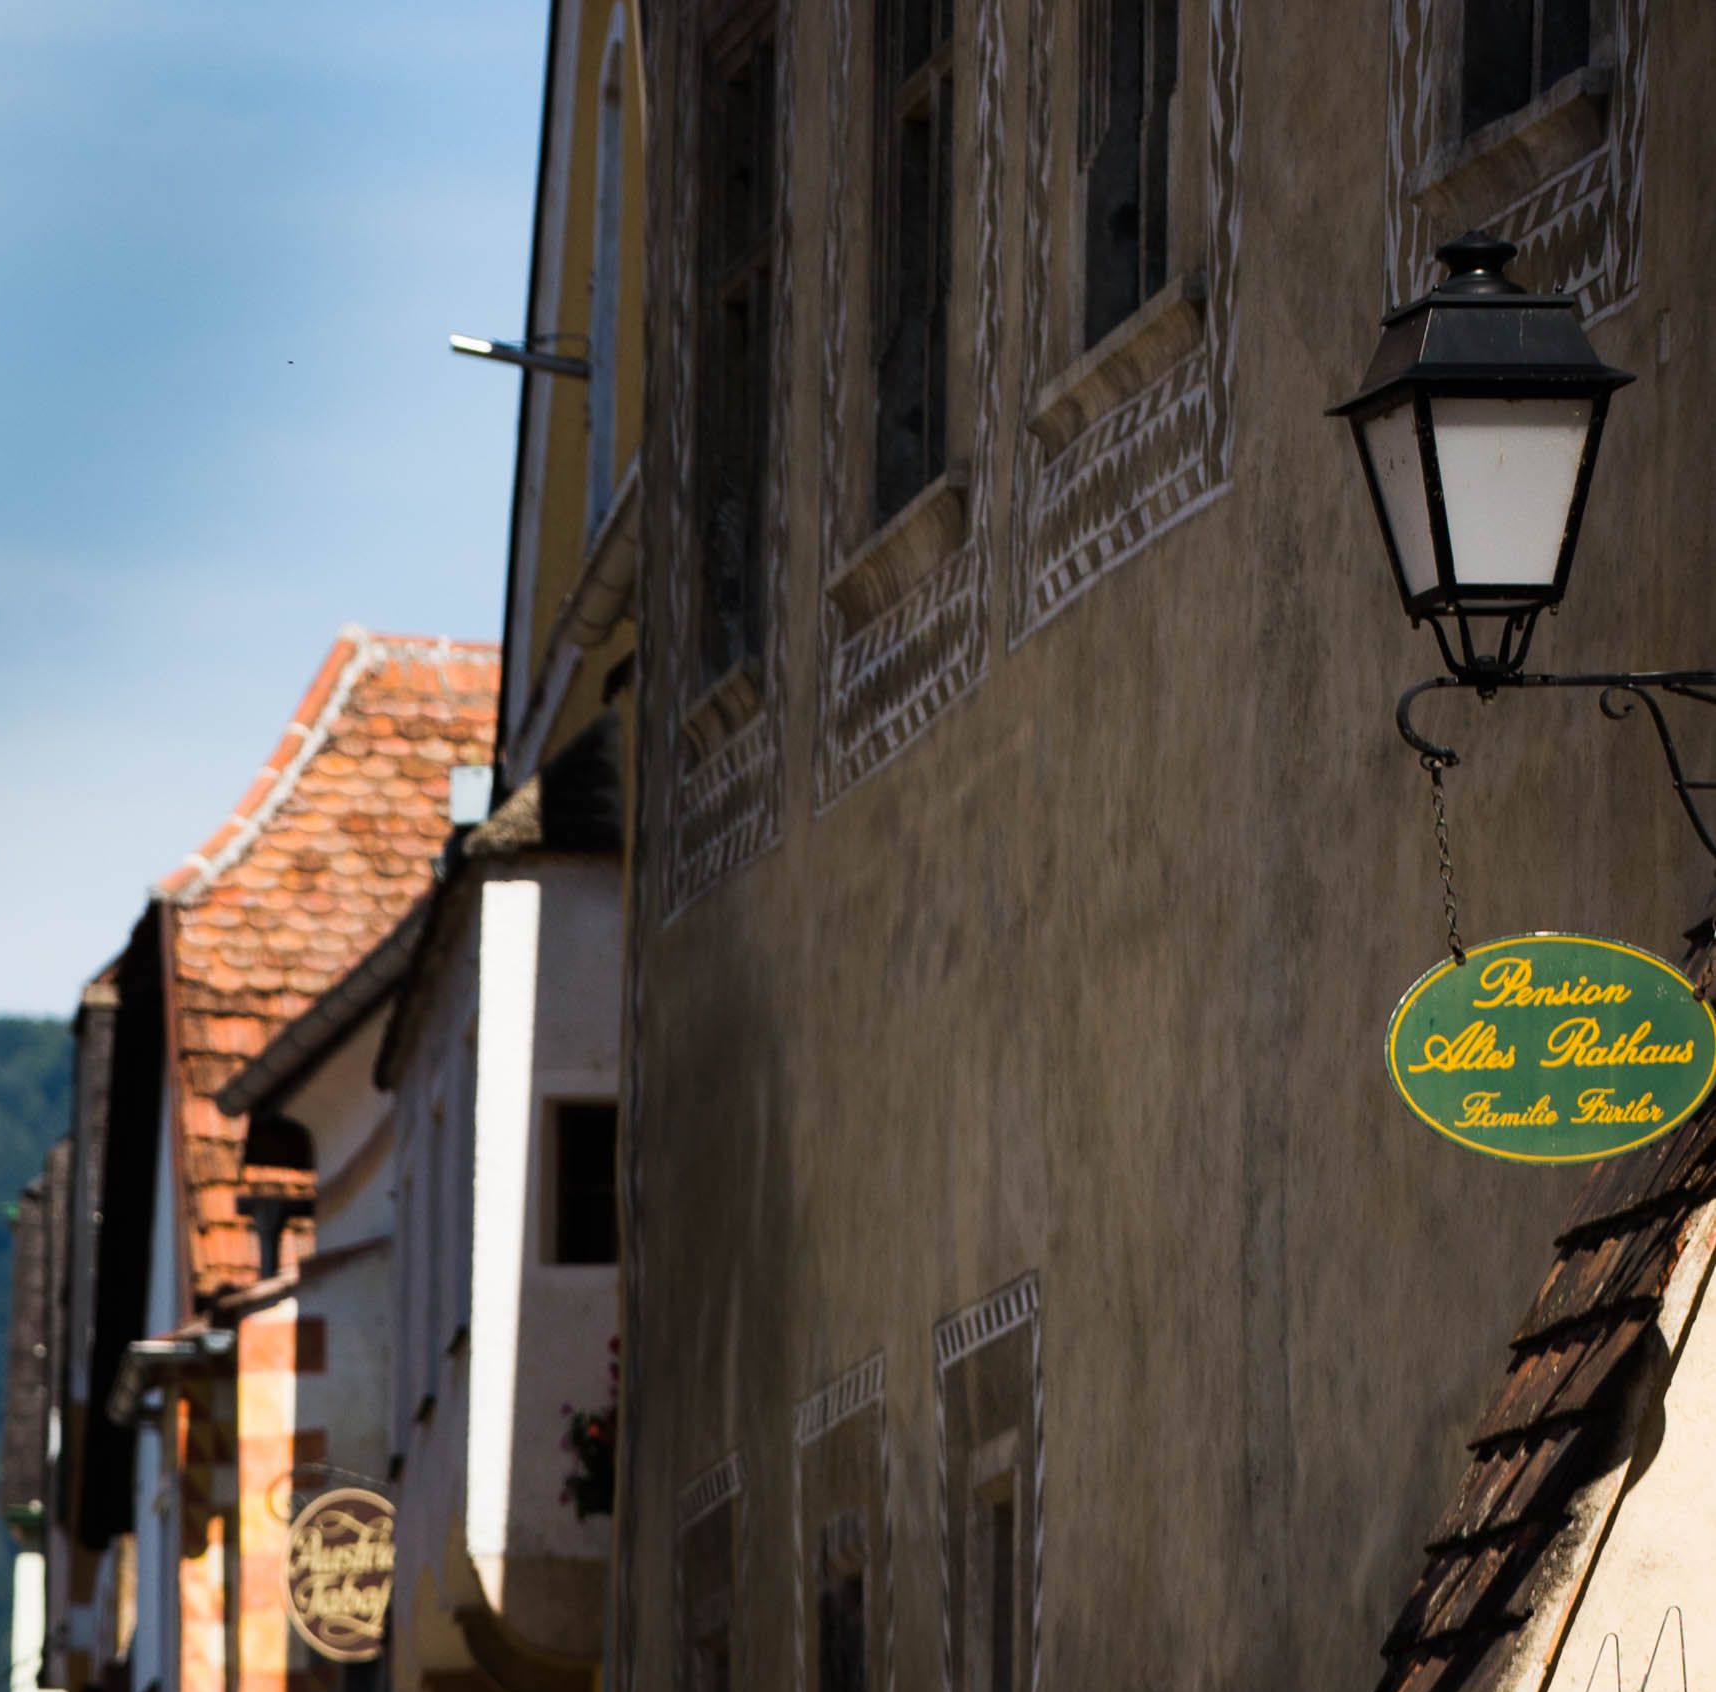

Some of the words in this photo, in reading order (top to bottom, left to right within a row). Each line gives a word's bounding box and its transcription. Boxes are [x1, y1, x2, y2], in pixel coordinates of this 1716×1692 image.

[1473, 957, 1632, 1009] Pension
[1408, 1021, 1516, 1073] Altes
[1540, 1017, 1695, 1068] Rathaus
[1454, 1092, 1559, 1128] Familie
